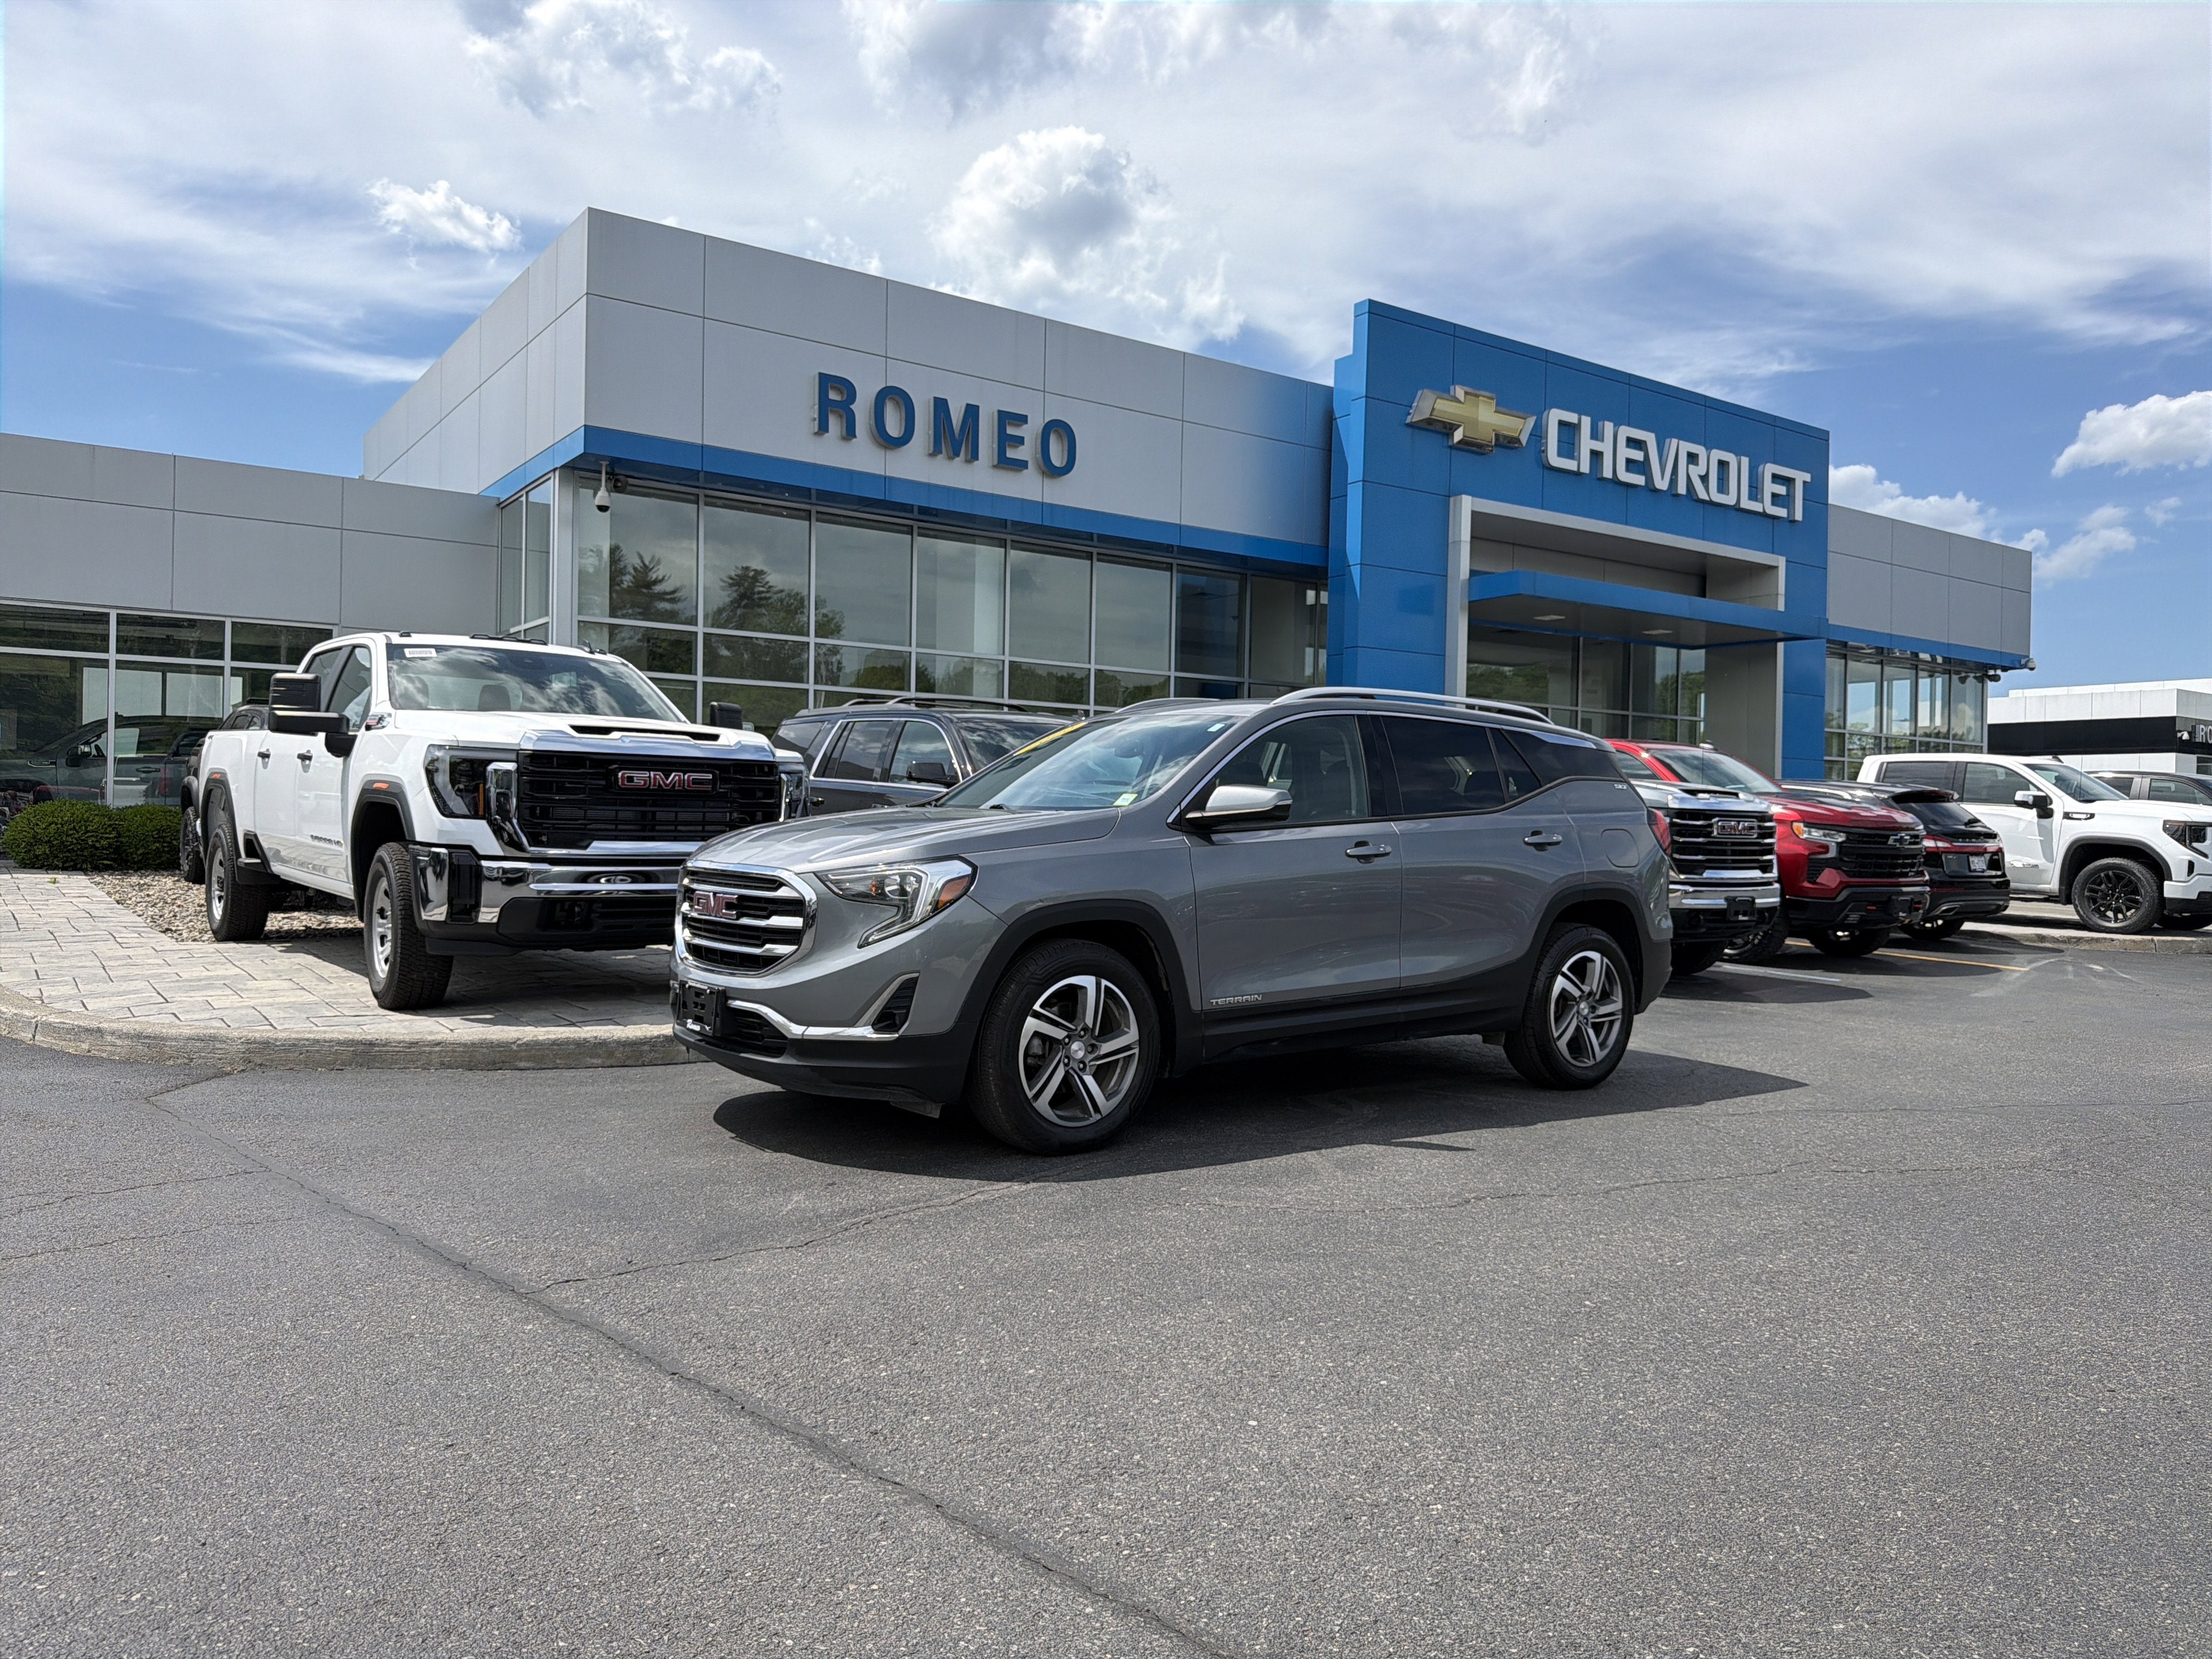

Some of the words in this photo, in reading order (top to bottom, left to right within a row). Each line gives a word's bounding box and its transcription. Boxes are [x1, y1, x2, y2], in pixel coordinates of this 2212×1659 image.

[815, 372, 1077, 477] ROMEO
[1542, 408, 1811, 522] CHEVROLET
[618, 770, 713, 791] GMC
[1718, 821, 1757, 834] GMC
[693, 890, 738, 919] GMC
[1210, 994, 1262, 1006] TERRAIN
